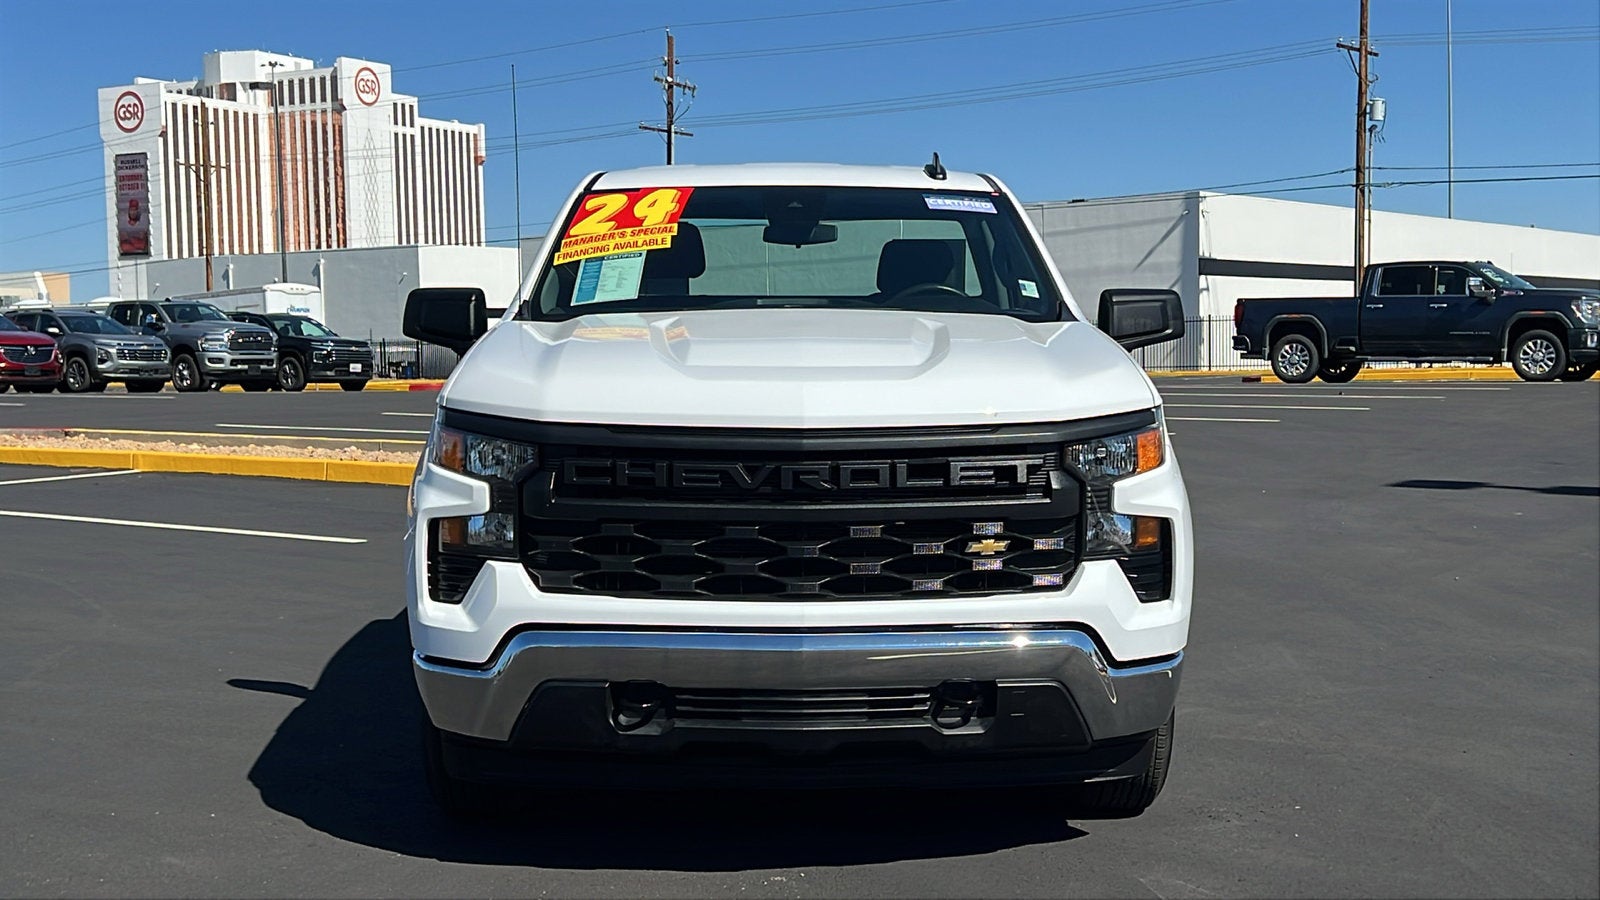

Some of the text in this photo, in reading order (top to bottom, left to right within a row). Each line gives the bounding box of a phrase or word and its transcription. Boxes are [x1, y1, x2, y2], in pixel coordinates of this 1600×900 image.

[358, 78, 377, 96] GSR
[118, 102, 140, 121] GSR
[569, 189, 681, 236] 24
[928, 198, 991, 209] CERTIFIED
[562, 225, 675, 249] MANAGER'S SPECIAL
[556, 237, 668, 262] FINANCING AVAILABLE
[564, 457, 1043, 490] CHEVROLET
